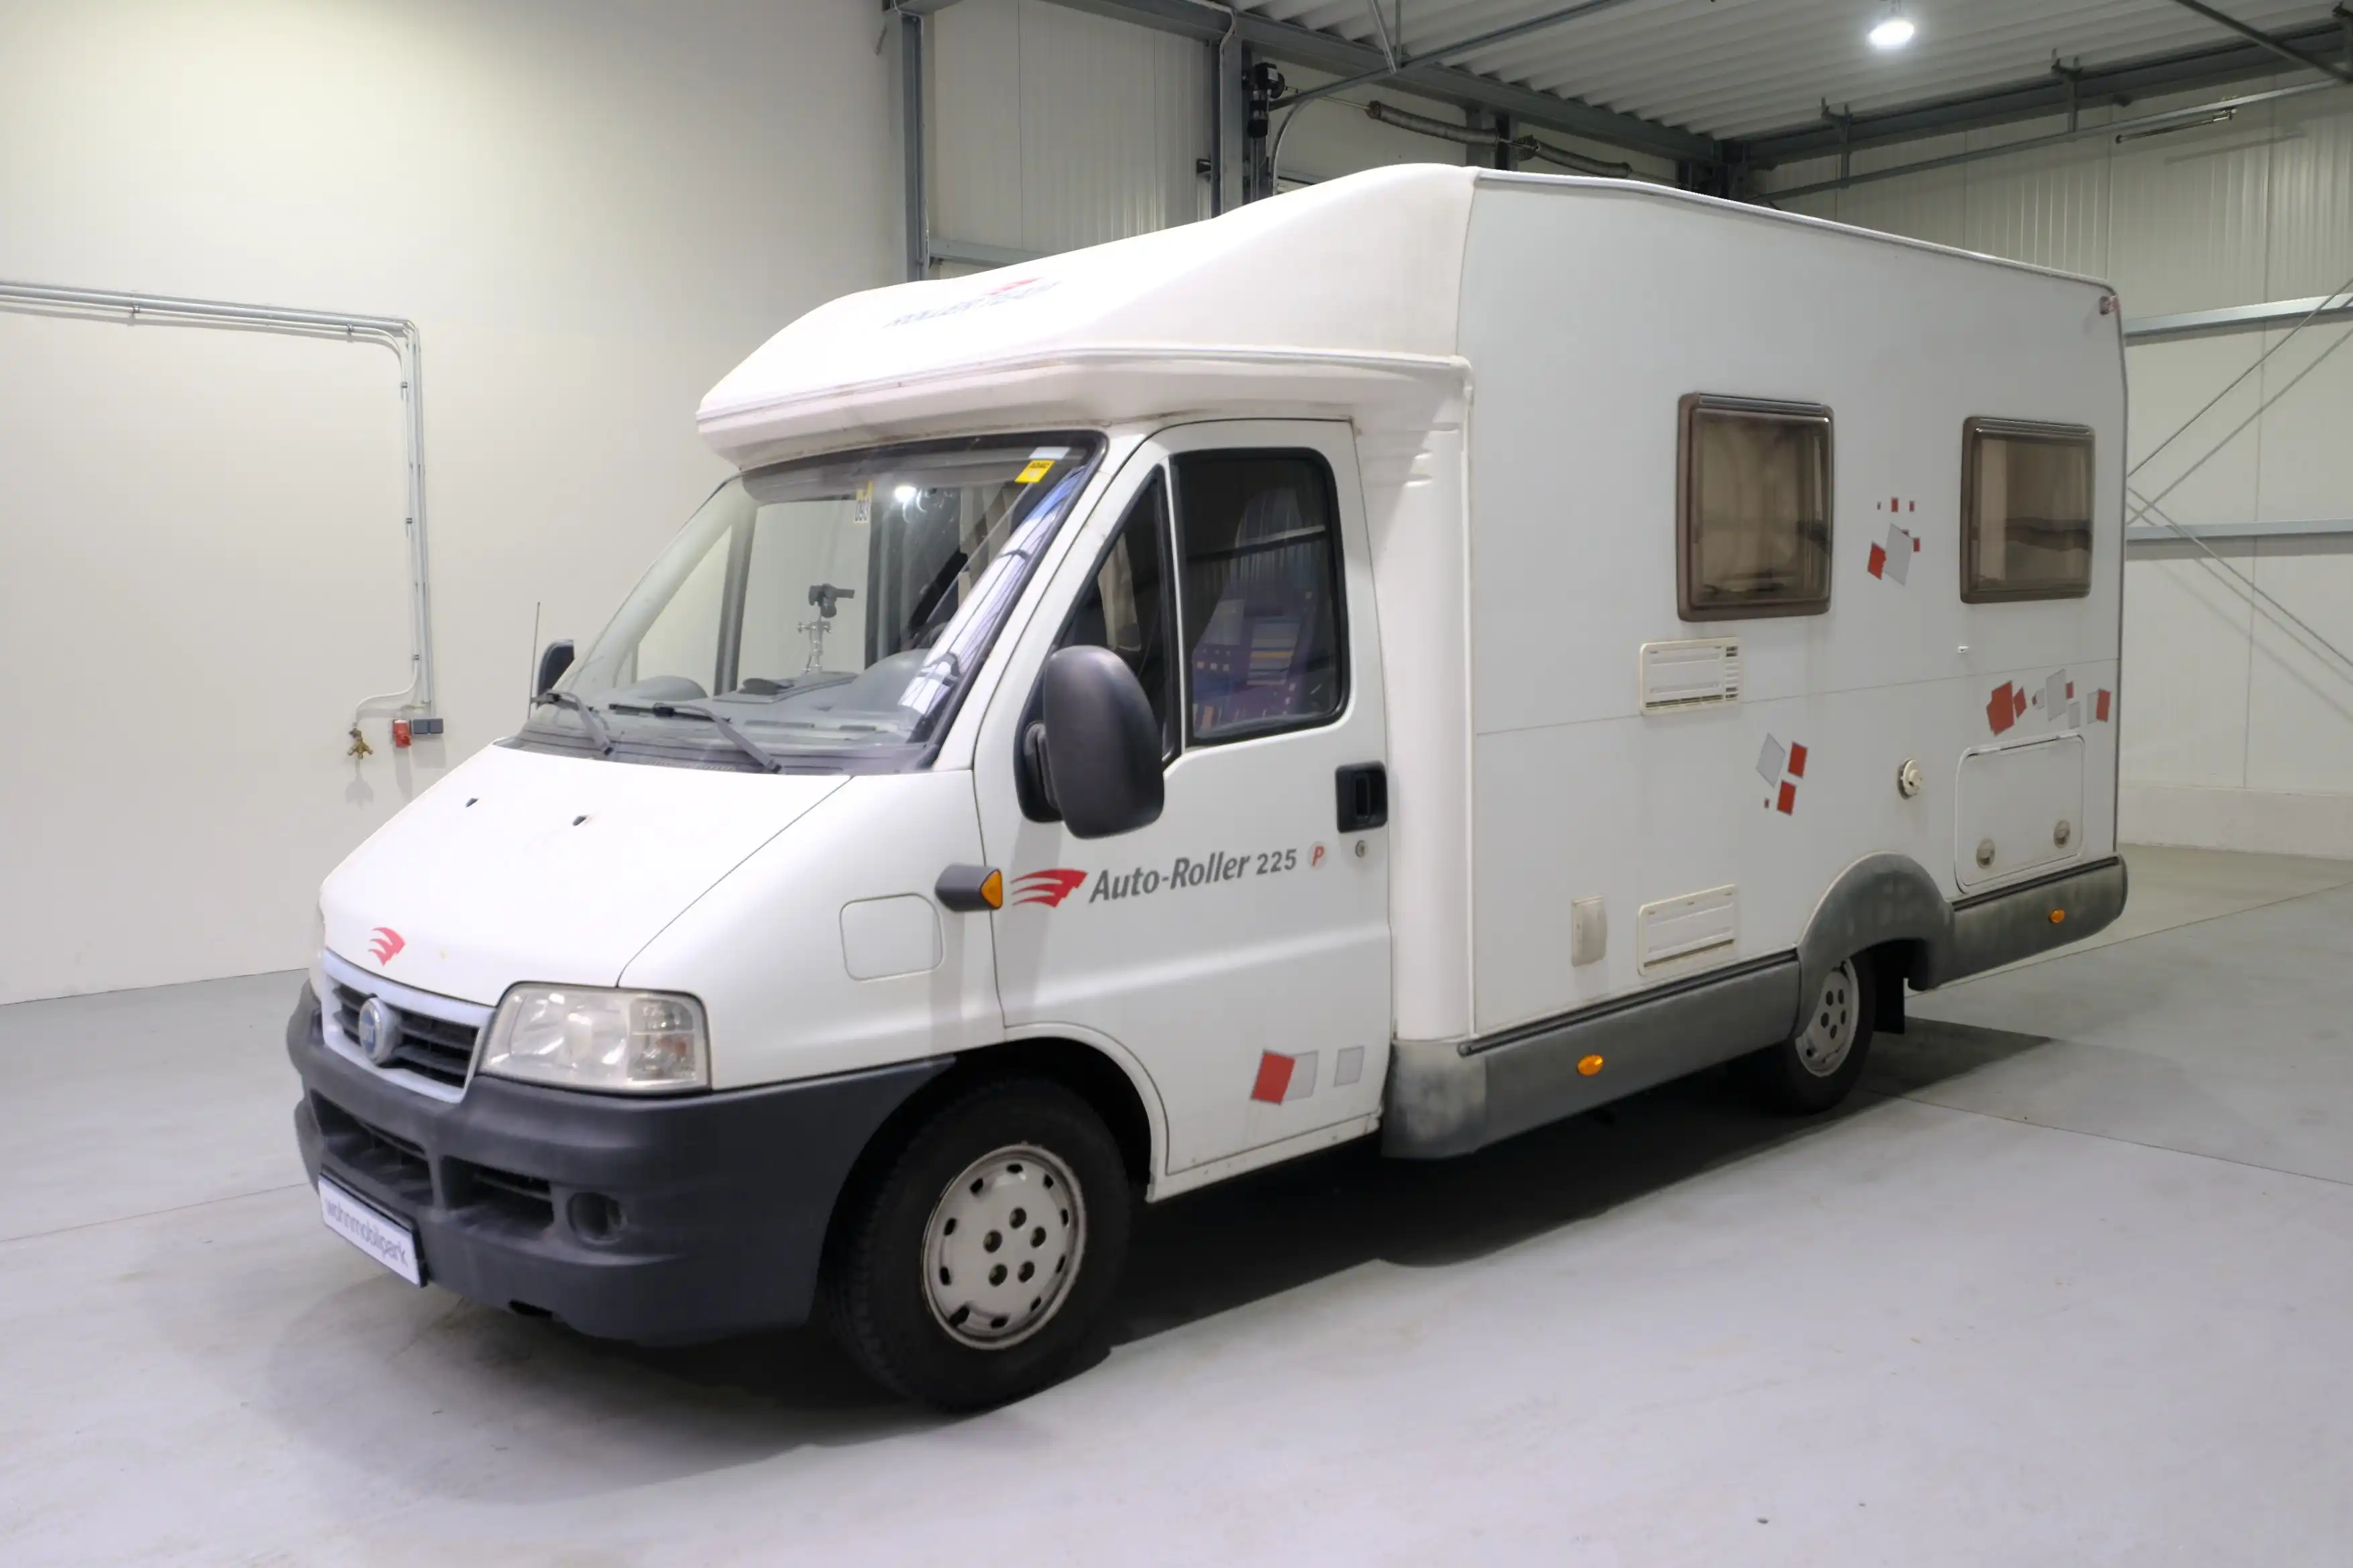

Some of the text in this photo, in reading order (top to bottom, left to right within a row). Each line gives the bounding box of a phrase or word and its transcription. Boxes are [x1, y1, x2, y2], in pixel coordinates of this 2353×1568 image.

[1089, 845, 1325, 904] Auto-Roller 225 P
